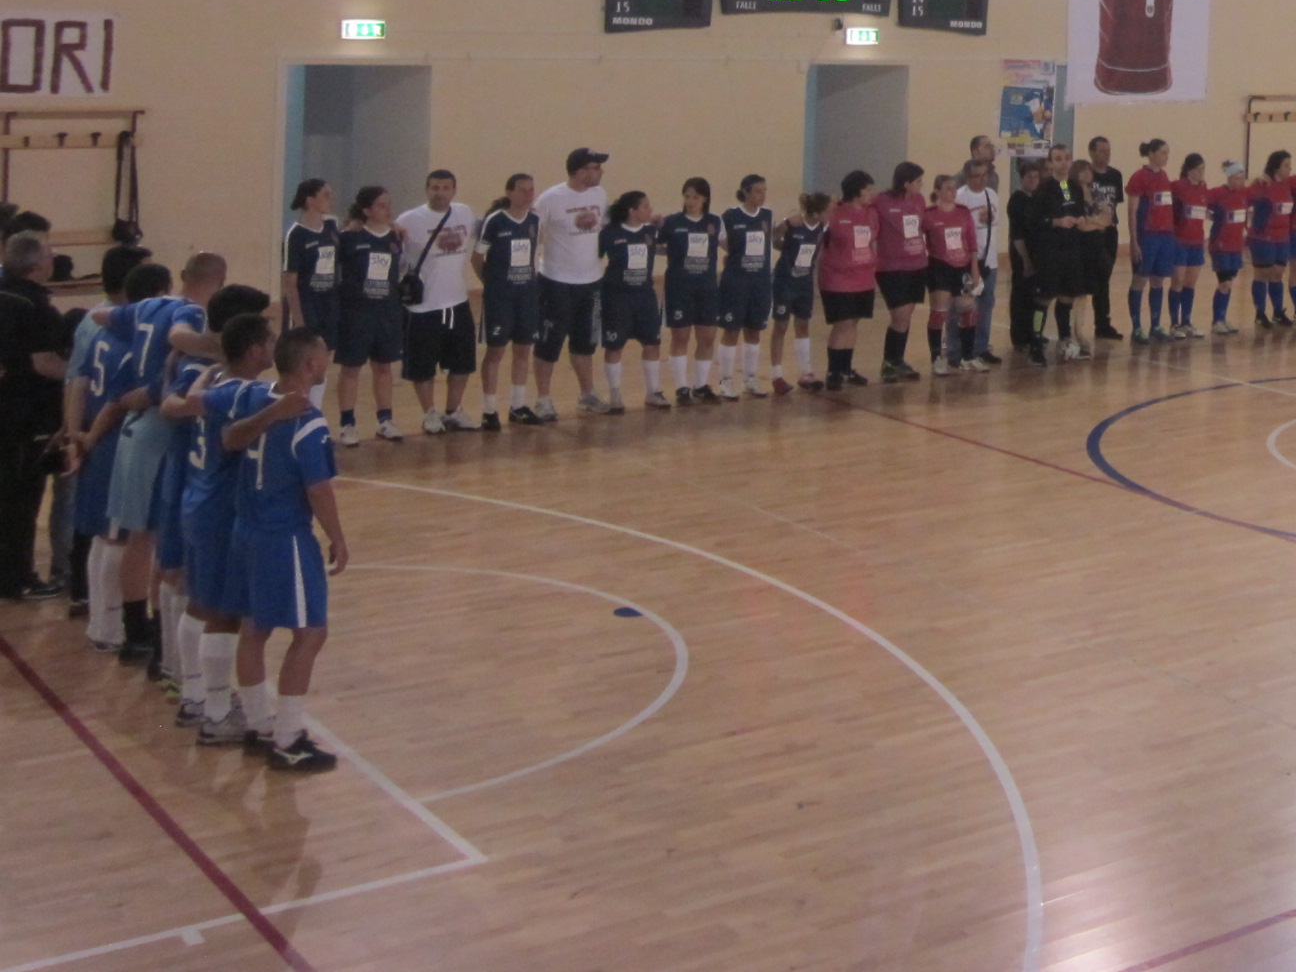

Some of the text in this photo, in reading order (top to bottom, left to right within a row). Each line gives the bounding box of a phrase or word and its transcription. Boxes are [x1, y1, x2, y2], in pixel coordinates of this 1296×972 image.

[616, 1, 630, 12] 15
[736, 1, 757, 10] FALLI
[862, 3, 882, 12] FALLI
[912, 6, 923, 16] 15
[612, 17, 653, 26] MONDO
[950, 20, 982, 28] MONDO
[138, 323, 154, 377] 7
[90, 340, 110, 397] 5
